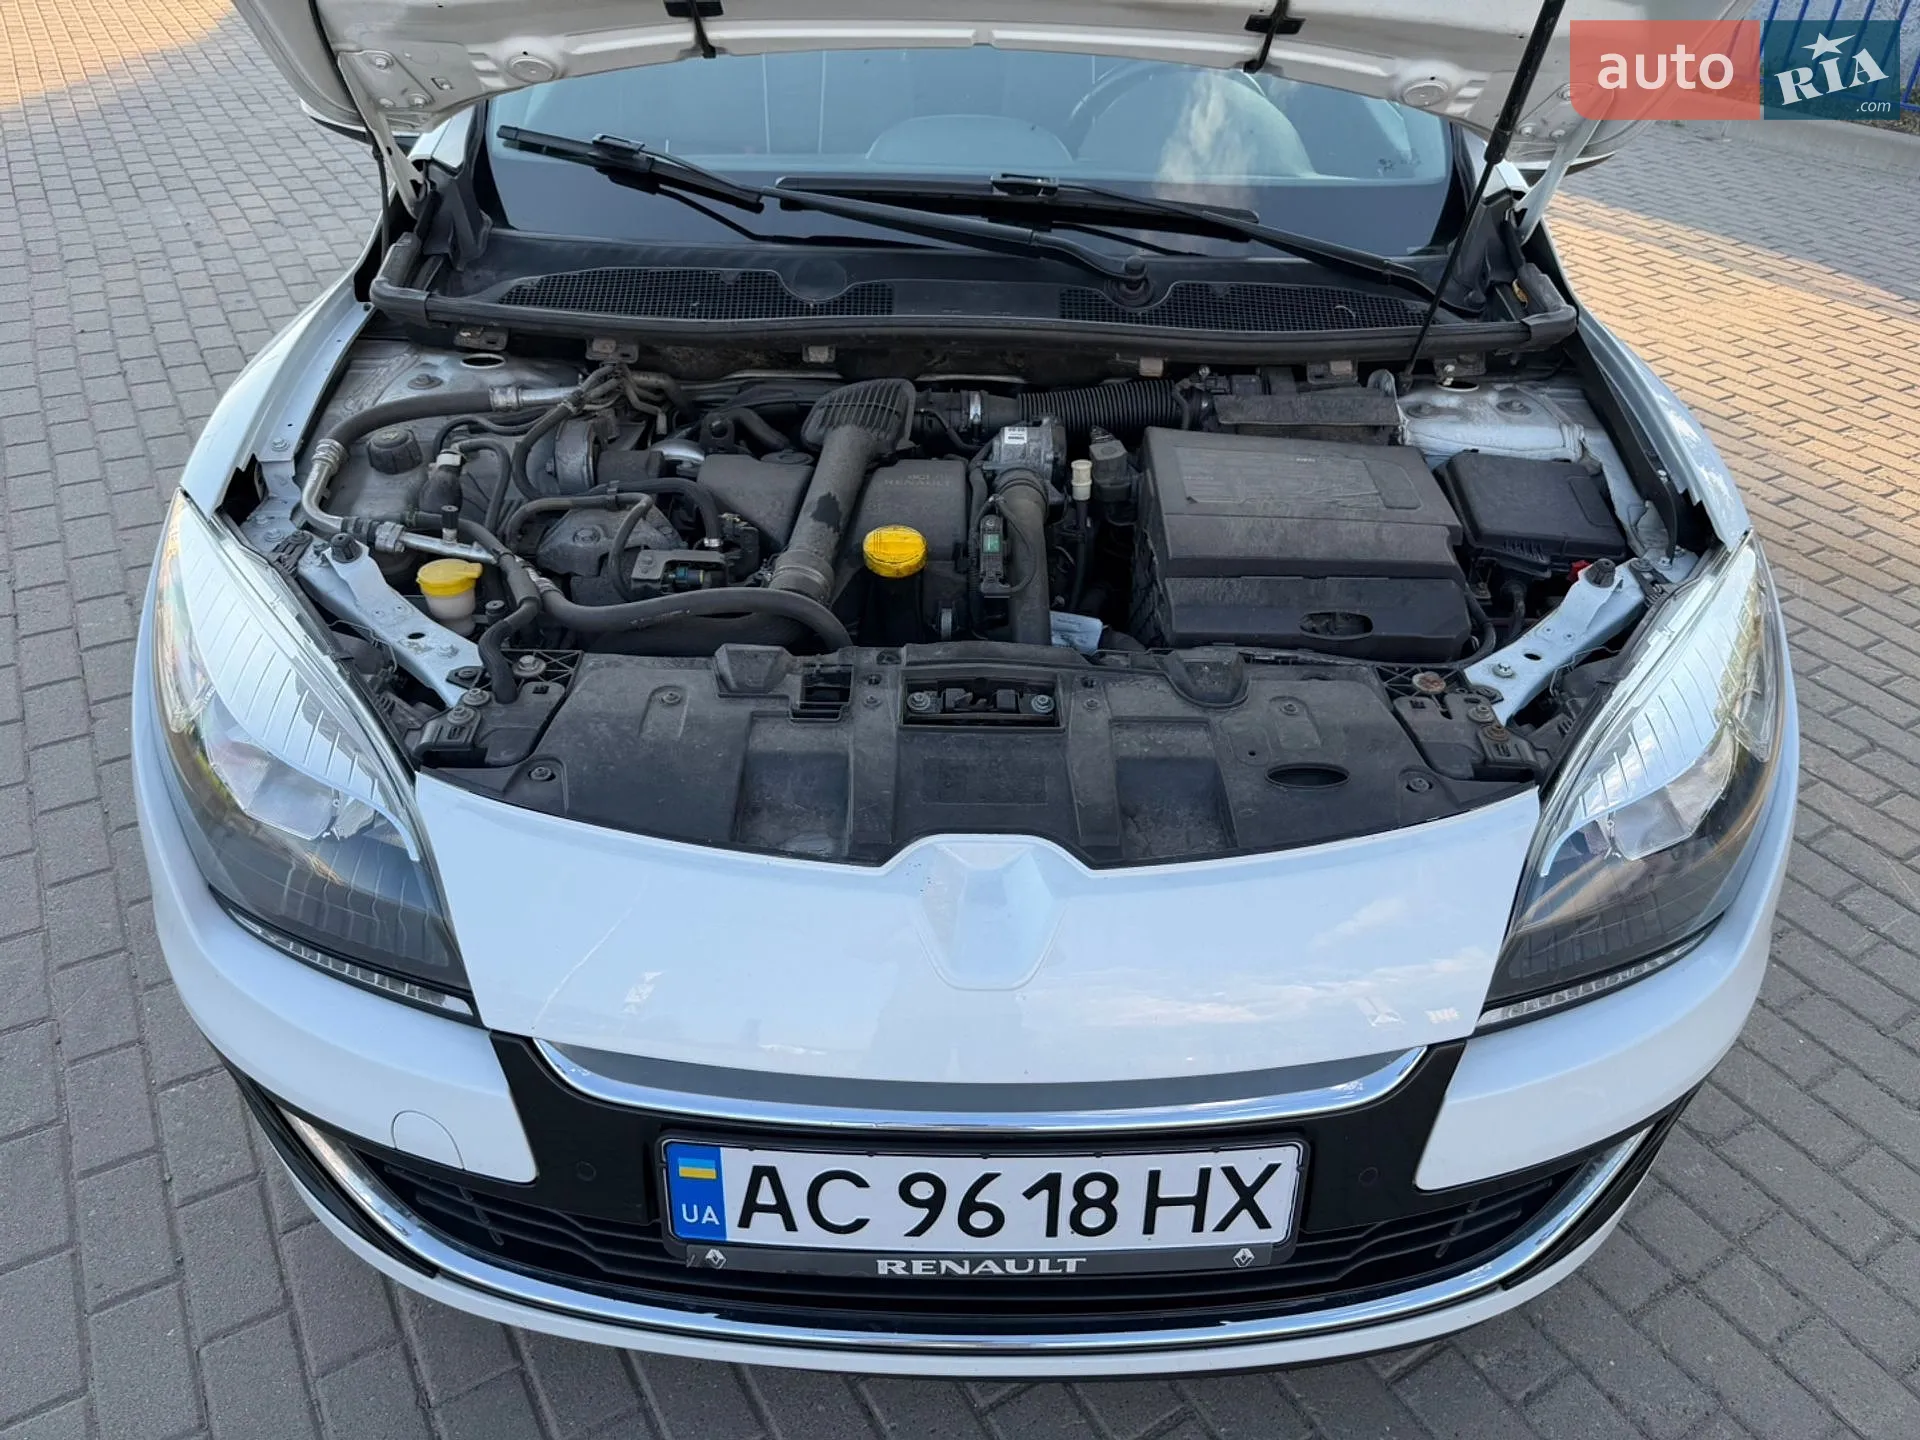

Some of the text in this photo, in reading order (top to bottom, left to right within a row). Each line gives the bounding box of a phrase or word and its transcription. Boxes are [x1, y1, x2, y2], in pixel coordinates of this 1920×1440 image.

[737, 1162, 1281, 1238] AC 9618 HX
[681, 1203, 720, 1225] UA
[876, 1257, 1086, 1276] RENAULT
